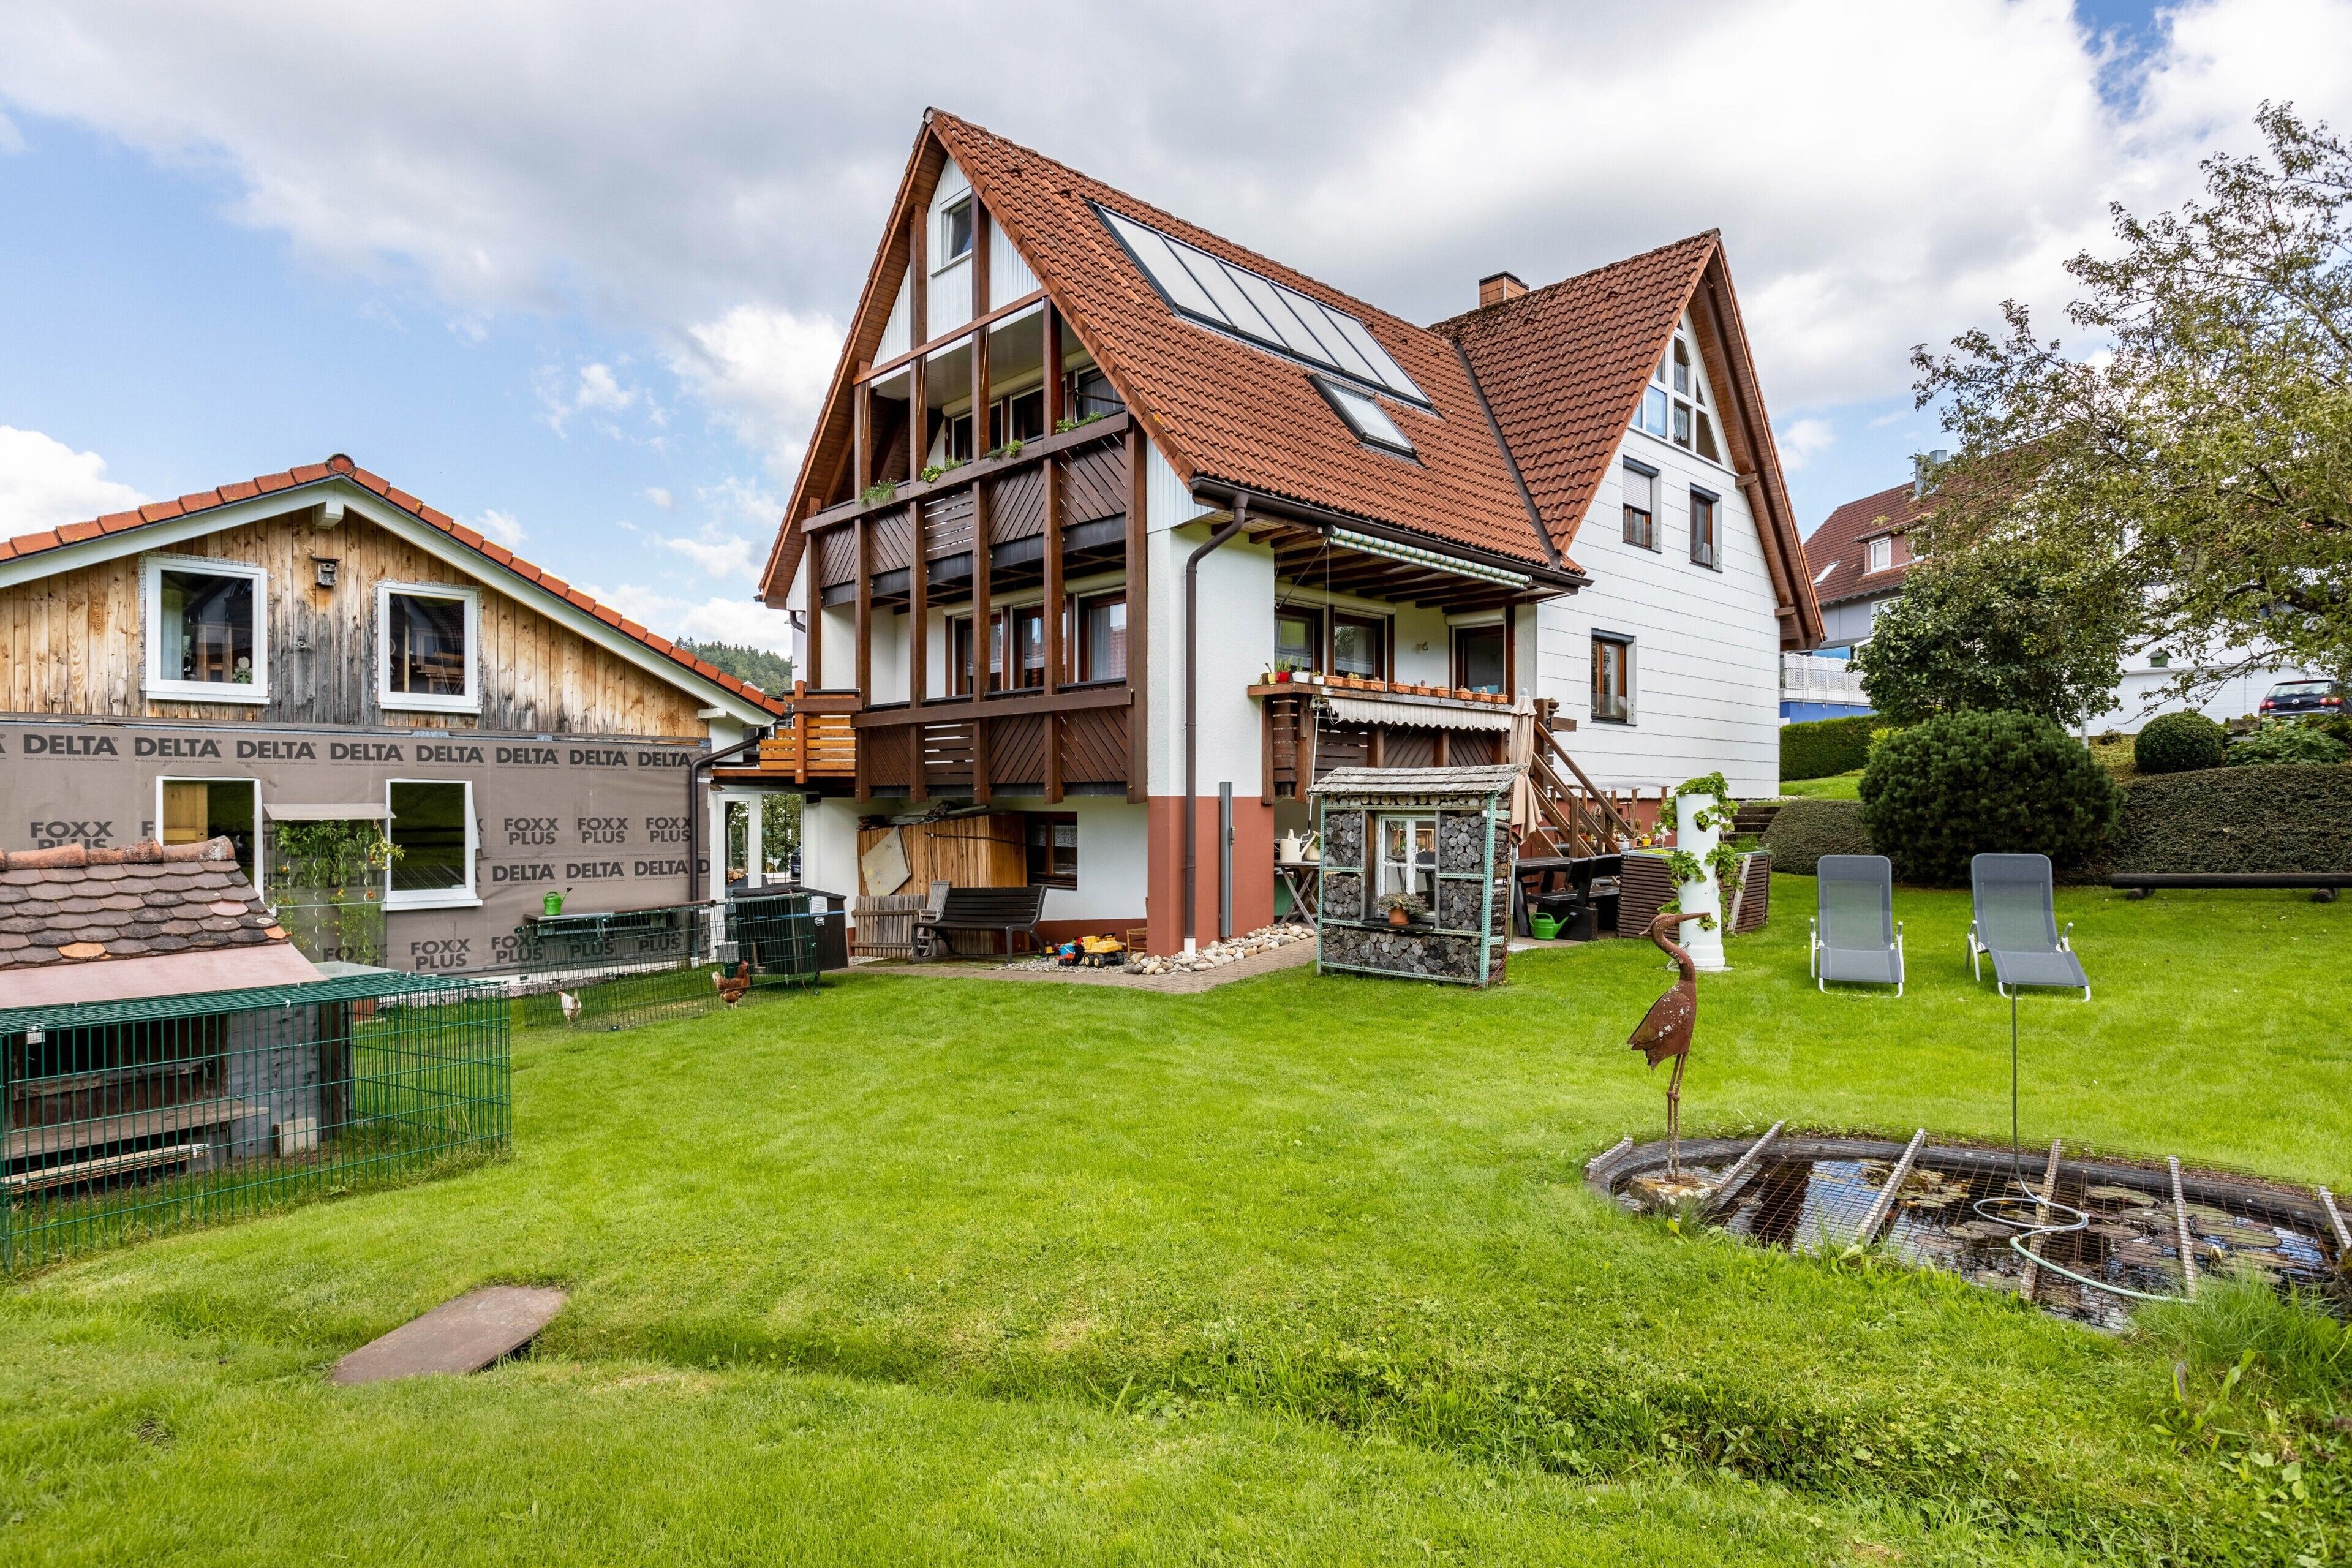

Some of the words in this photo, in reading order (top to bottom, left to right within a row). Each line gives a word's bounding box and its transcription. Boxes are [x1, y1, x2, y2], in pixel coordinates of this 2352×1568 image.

[31, 821, 113, 838] FOXX
[504, 818, 559, 831] FOXX
[578, 817, 628, 831] FOXX
[646, 817, 690, 829] FOXX
[509, 831, 556, 845] PLUS
[582, 831, 625, 843] PLUS
[650, 829, 691, 842] PLUS
[411, 938, 471, 956] FOXX
[639, 937, 680, 952] PLUS
[417, 953, 467, 970] PLUS
[496, 948, 543, 963] PLUS
